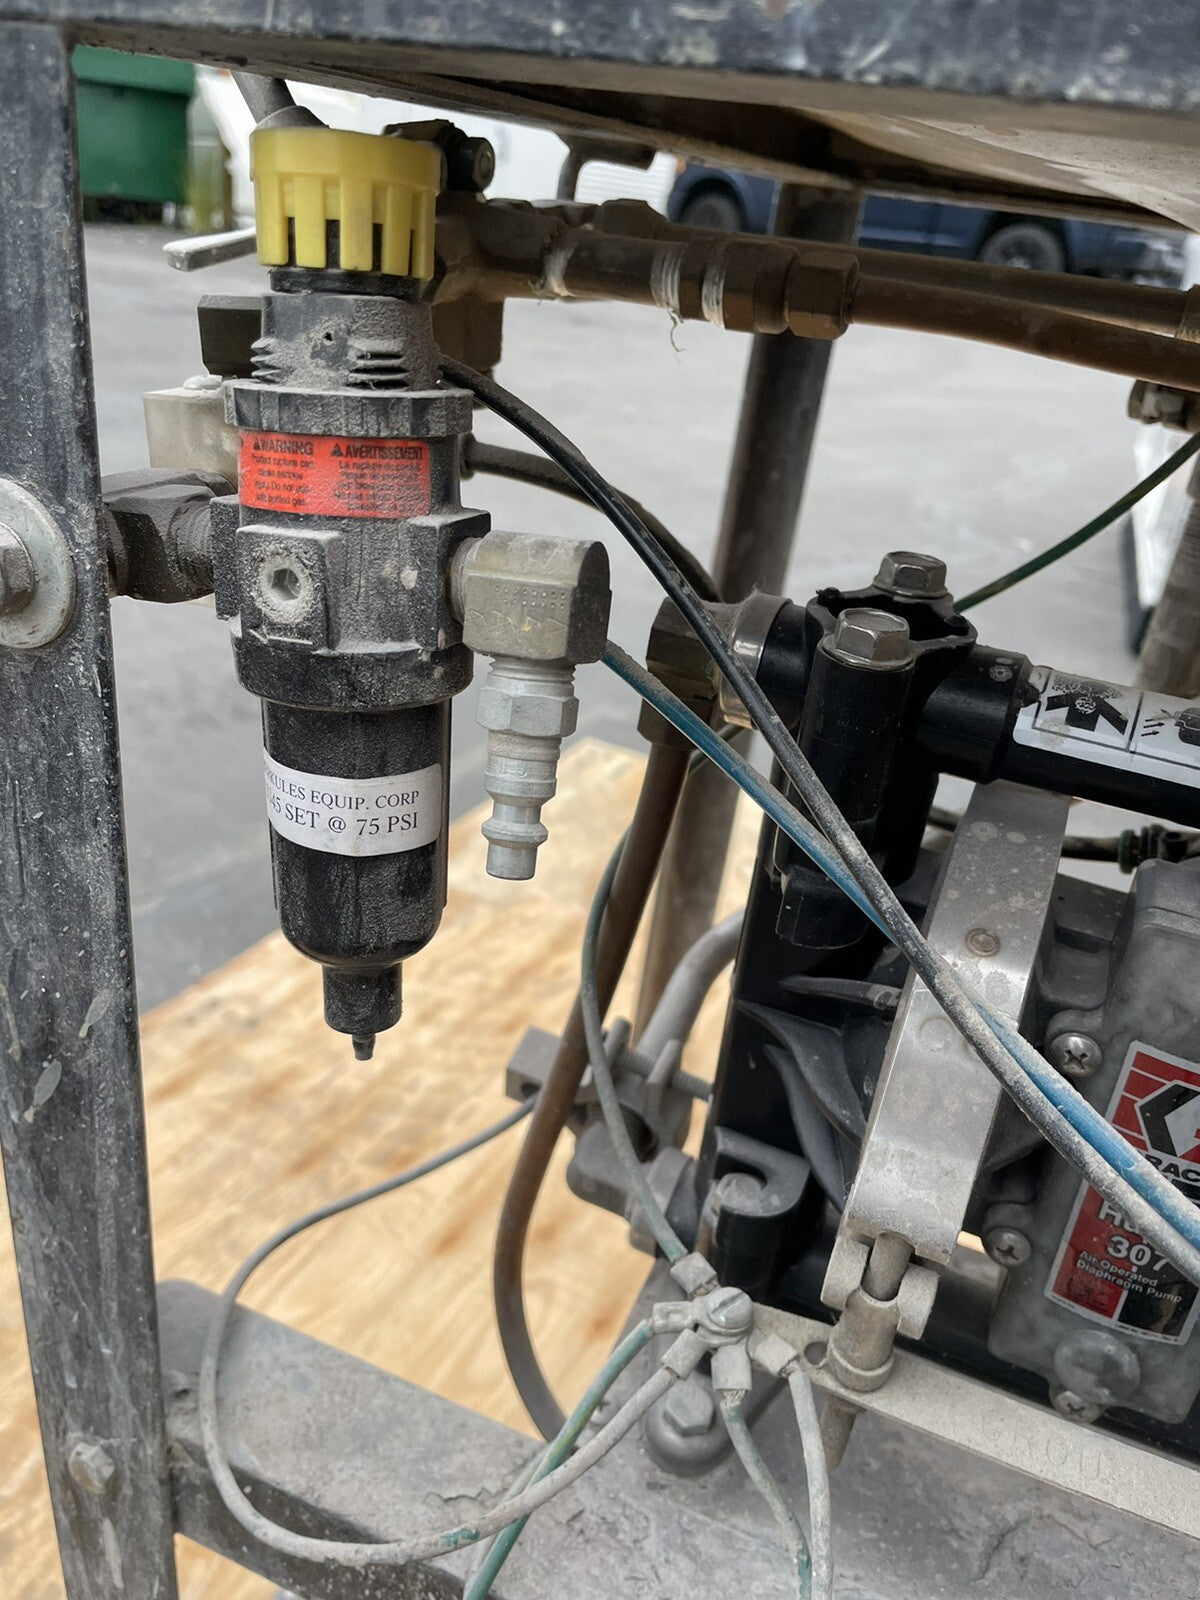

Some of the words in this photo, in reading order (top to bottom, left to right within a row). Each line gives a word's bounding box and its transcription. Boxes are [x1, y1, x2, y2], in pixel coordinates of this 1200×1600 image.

[260, 438, 314, 456] WARNING
[310, 790, 370, 810] EQUIP.
[375, 790, 420, 809] CORP
[285, 802, 320, 829] SET
[328, 816, 347, 834] @
[356, 817, 380, 836] 75
[387, 812, 419, 833] PSI
[1076, 1259, 1144, 1292] Diaphragm
[1146, 1288, 1183, 1304] Pump
[1079, 1251, 1098, 1265] Air
[1100, 1258, 1159, 1287] Operated
